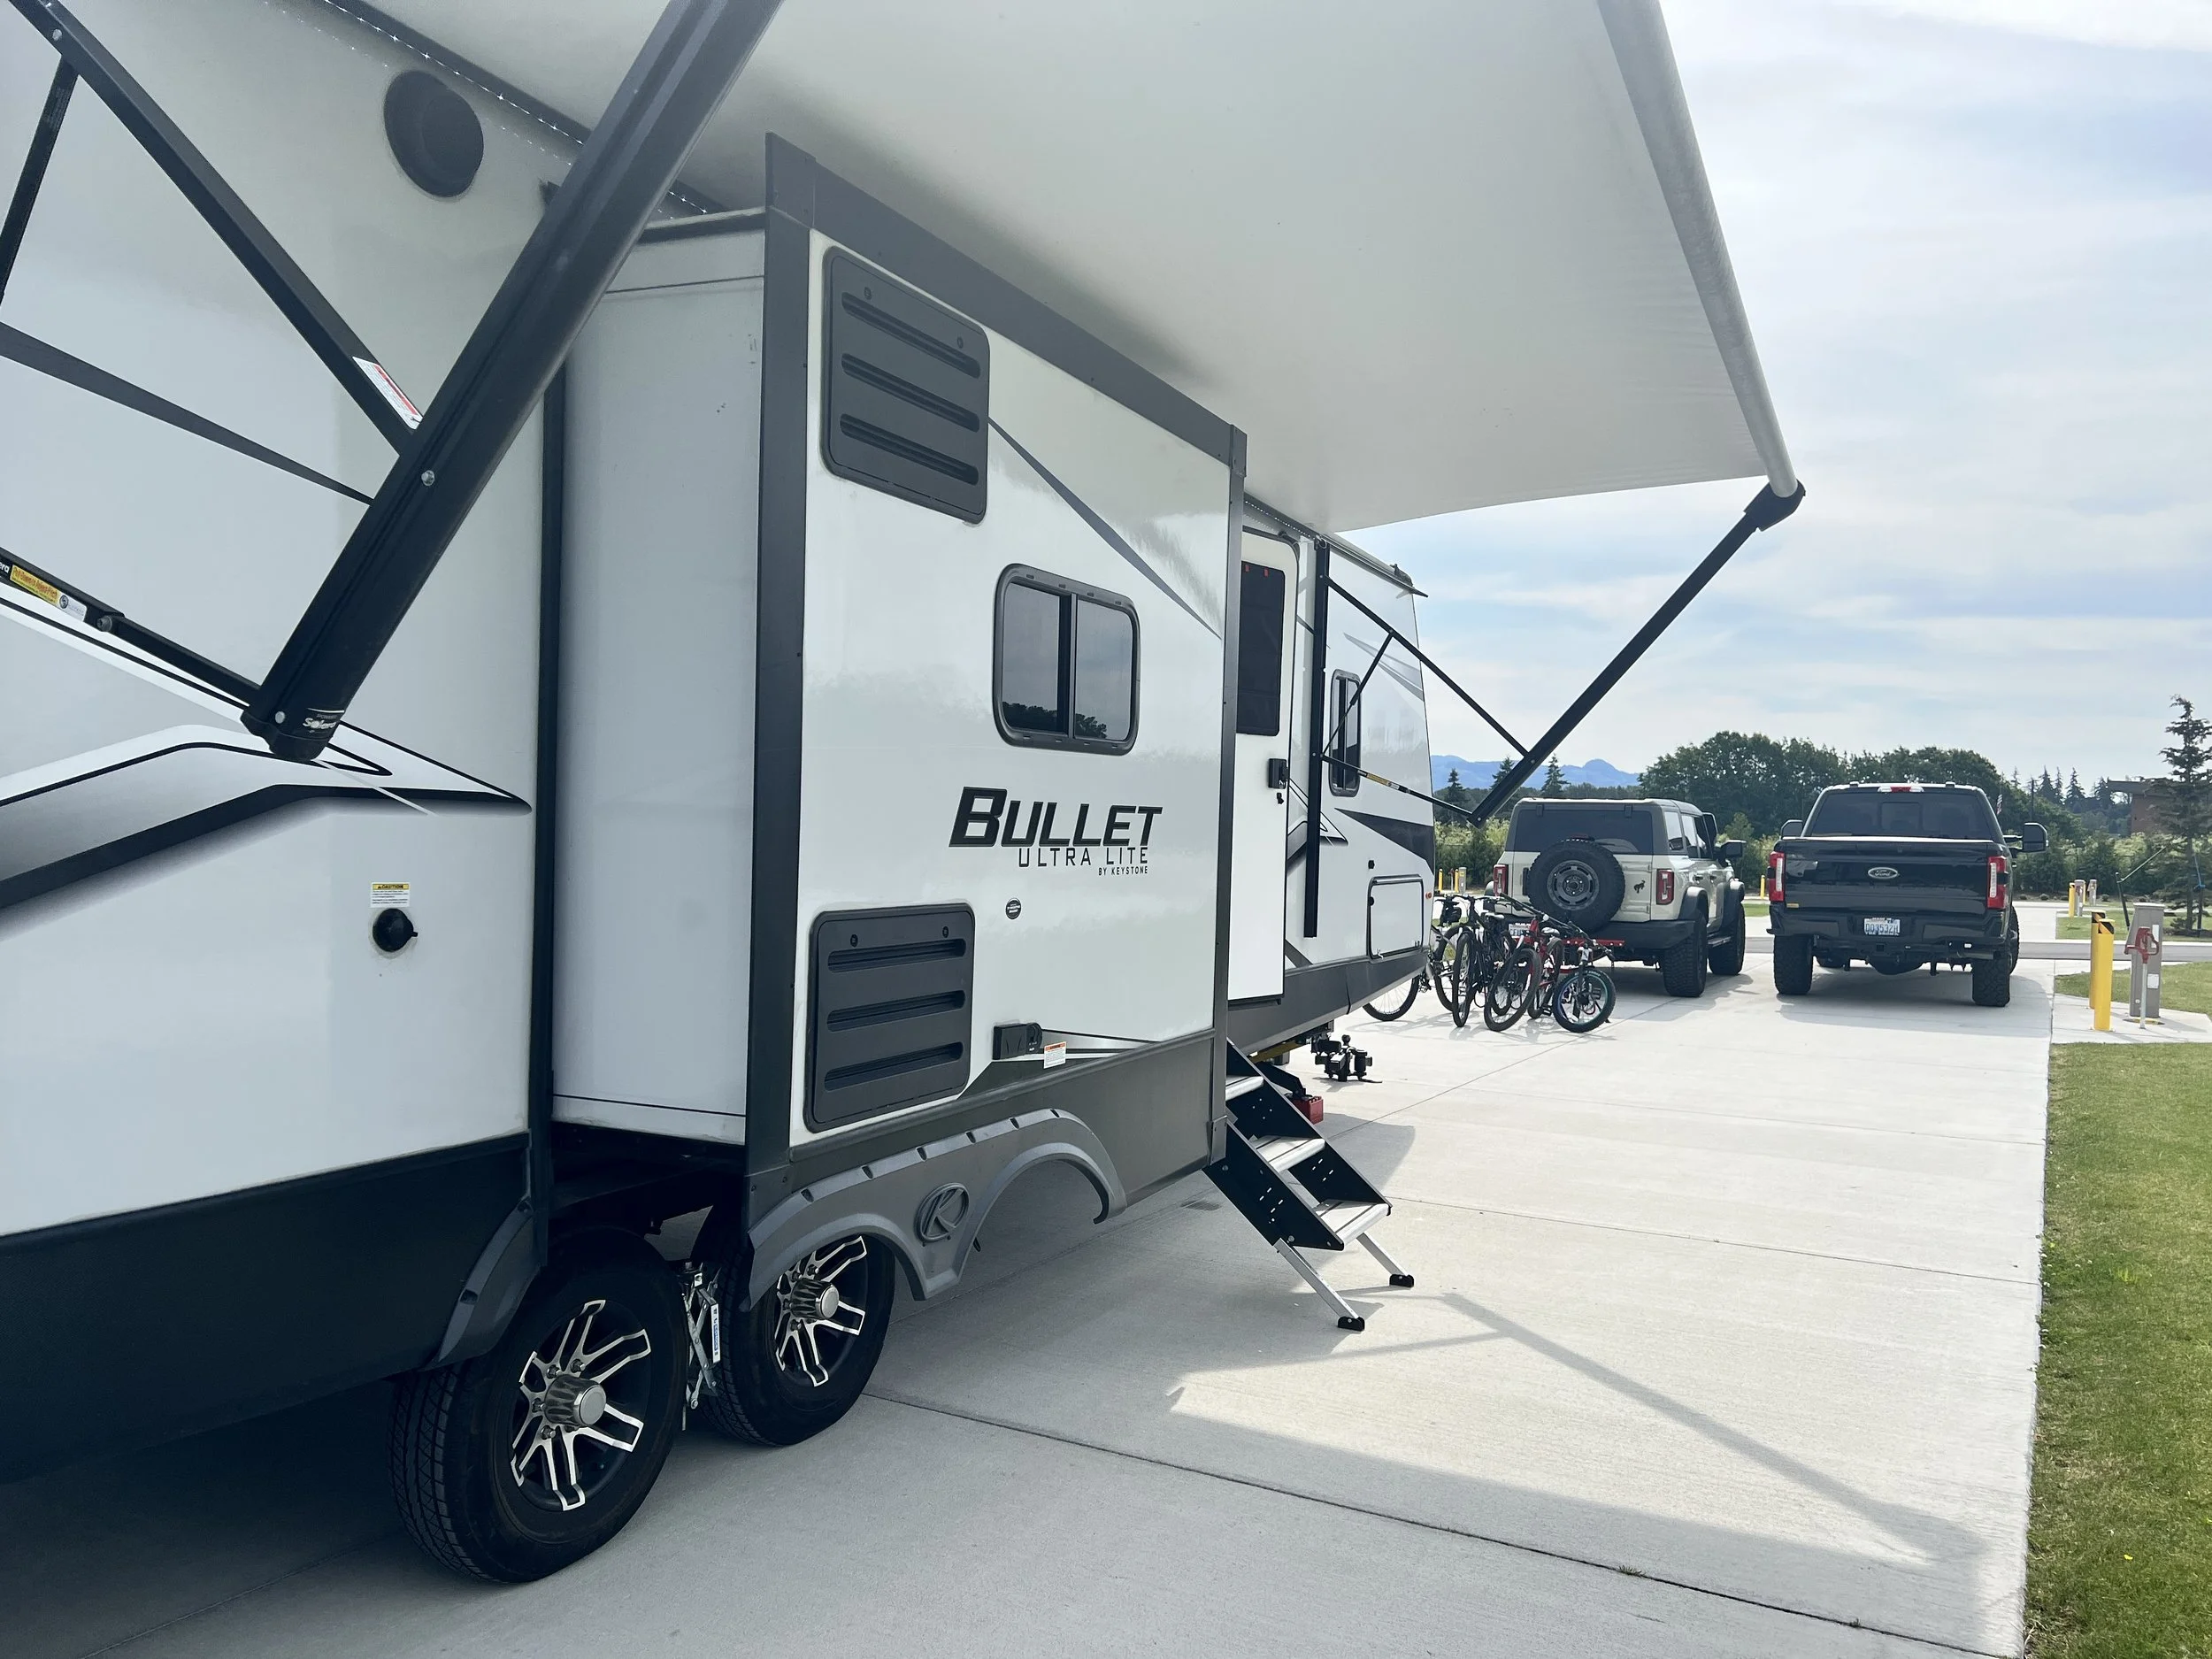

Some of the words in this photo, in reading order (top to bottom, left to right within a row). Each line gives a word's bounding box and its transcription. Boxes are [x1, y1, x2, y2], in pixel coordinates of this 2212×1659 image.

[949, 786, 1163, 847] BULLET
[1018, 847, 1092, 867] ULTRA
[1106, 847, 1148, 865] LITE
[1098, 867, 1108, 876] BY
[1110, 866, 1148, 876] KEYSTONE
